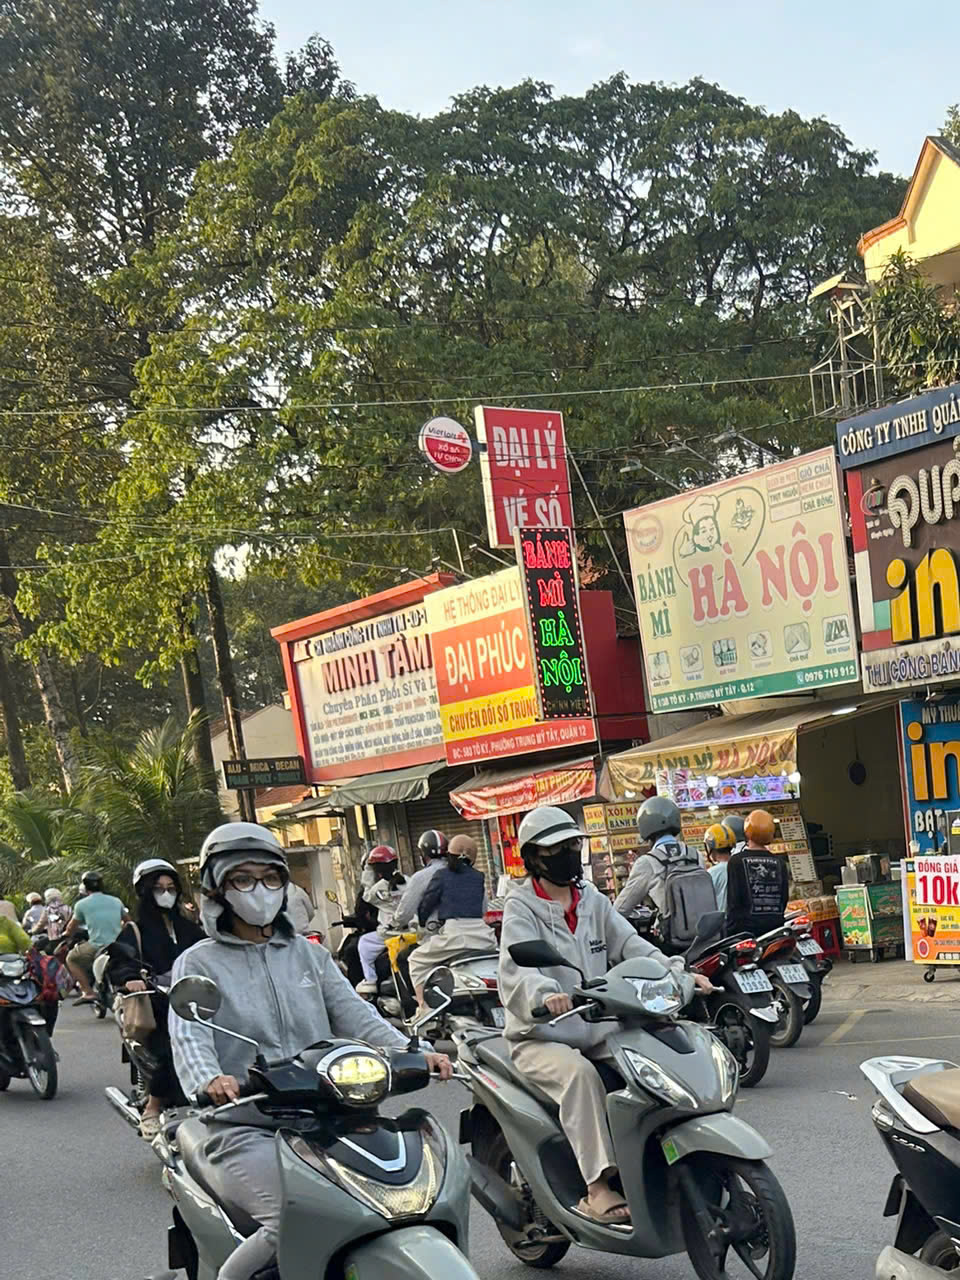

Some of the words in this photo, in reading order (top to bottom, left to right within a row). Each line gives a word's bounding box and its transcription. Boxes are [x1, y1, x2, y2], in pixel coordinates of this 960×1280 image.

[493, 425, 530, 477] ĐẠI
[533, 421, 557, 470] LÝ
[841, 424, 872, 456] CÔNG
[874, 421, 891, 445] TY
[893, 410, 927, 440] TNHH
[523, 533, 571, 569] BÁNH
[637, 564, 676, 602] BÁNH
[688, 541, 749, 623] HÀ
[756, 520, 840, 612] NỘI
[539, 610, 574, 647] HÀ
[650, 602, 672, 638] MÌ
[321, 649, 379, 694] MINH
[380, 633, 433, 679] TÂM
[445, 640, 475, 693] ĐẠI
[477, 620, 526, 677] PHÚC
[540, 651, 583, 694] NỘI
[805, 670, 823, 682] 0976
[825, 667, 839, 679] 719
[841, 665, 855, 677] 912
[890, 652, 929, 681] CÔNG
[323, 697, 353, 715] Chuyên
[355, 692, 378, 709] Phân
[380, 682, 401, 703] Phối
[415, 678, 427, 692] Và
[449, 706, 482, 732] CHUYÊN
[481, 700, 496, 726] ĐỔI
[498, 697, 509, 722] SỐ
[922, 703, 938, 723] MỸ
[560, 724, 578, 741] QUẬN
[579, 725, 587, 737] 12
[717, 742, 739, 771] HÀ
[944, 859, 959, 874] GIÁ
[919, 875, 959, 905] 10k
